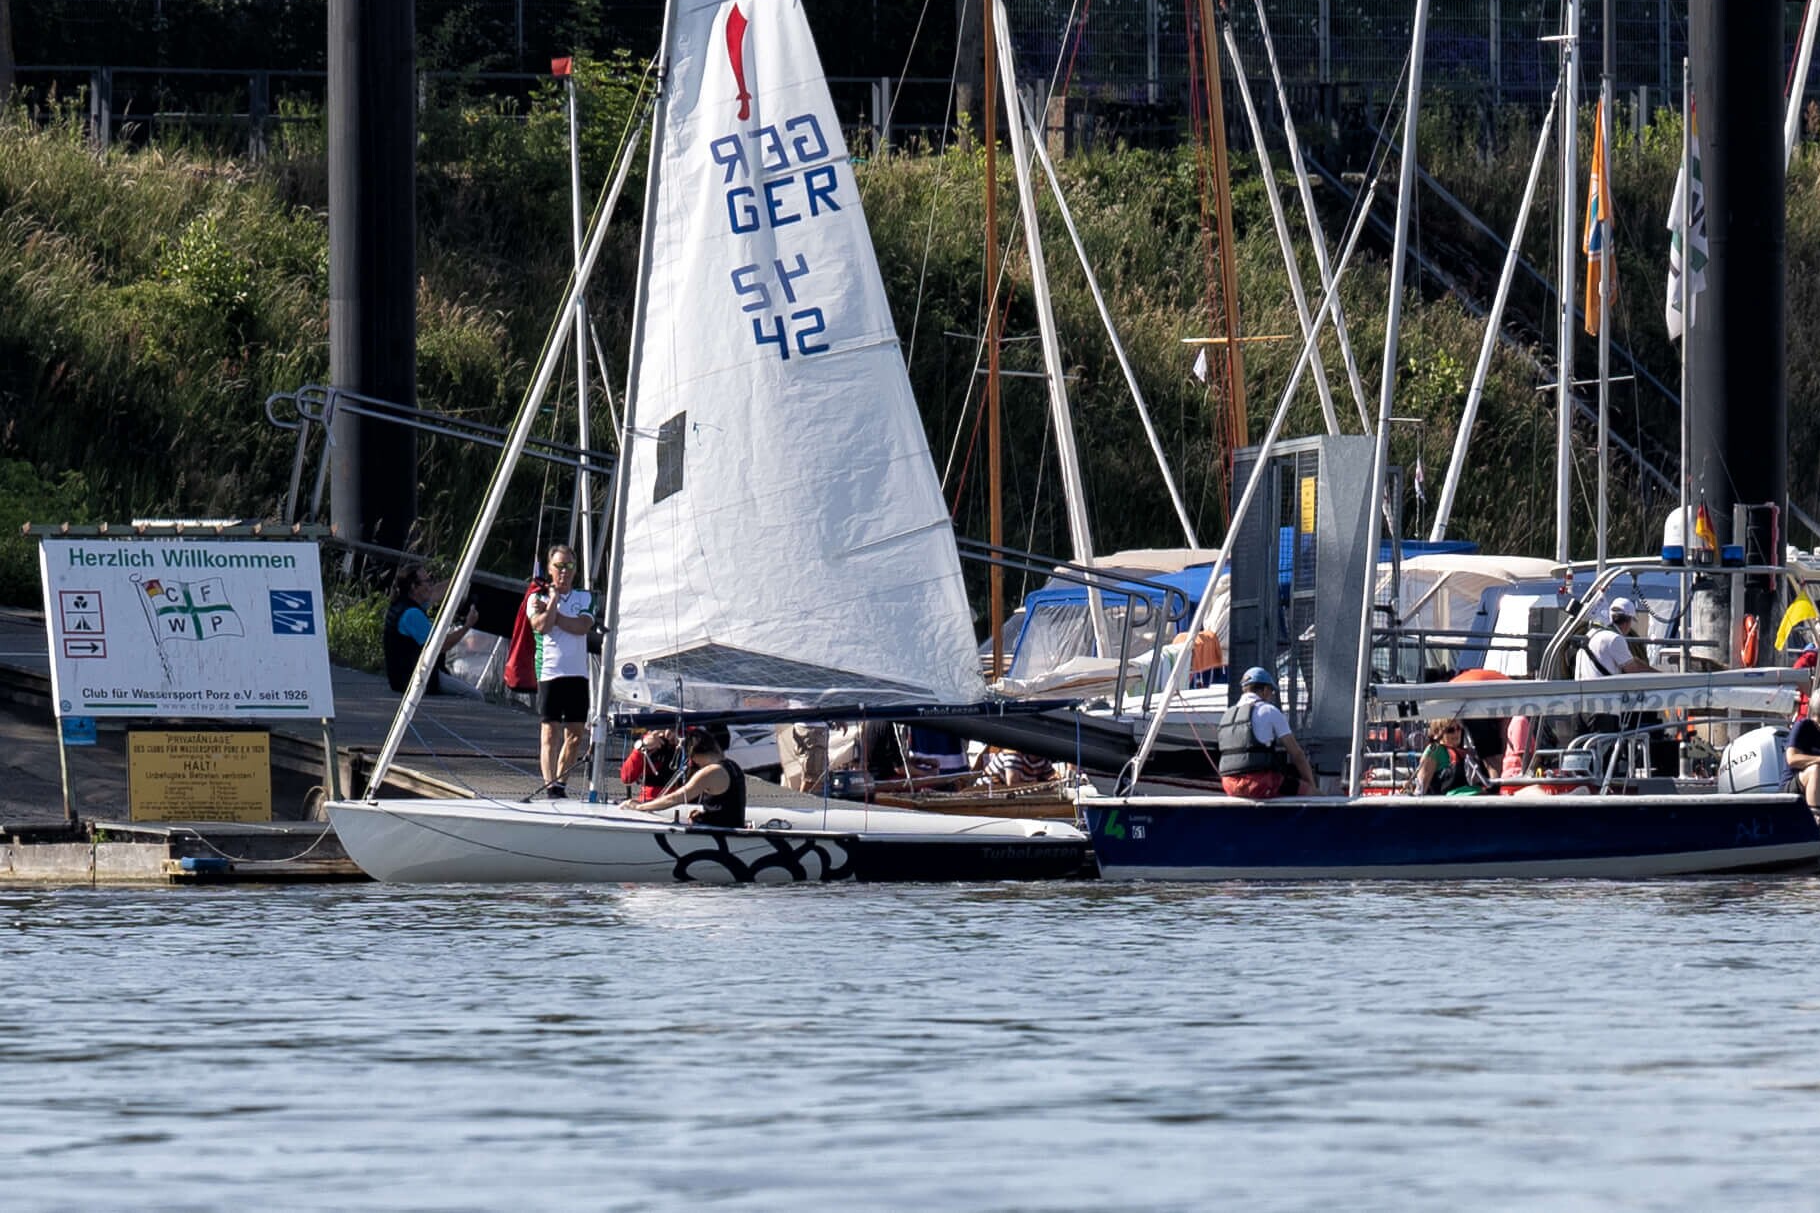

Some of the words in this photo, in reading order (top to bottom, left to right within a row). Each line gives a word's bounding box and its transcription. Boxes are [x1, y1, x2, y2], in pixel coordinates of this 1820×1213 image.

[726, 164, 841, 235] GER
[752, 306, 830, 362] 42
[69, 548, 155, 567] Herzlich
[161, 549, 297, 568] Willkommen
[82, 688, 108, 699] Club
[112, 688, 128, 699] für
[132, 689, 202, 701] Wassersport
[206, 690, 230, 700] Porz
[259, 690, 280, 700] seit
[284, 690, 308, 700] 1926
[183, 761, 210, 771] HALT
